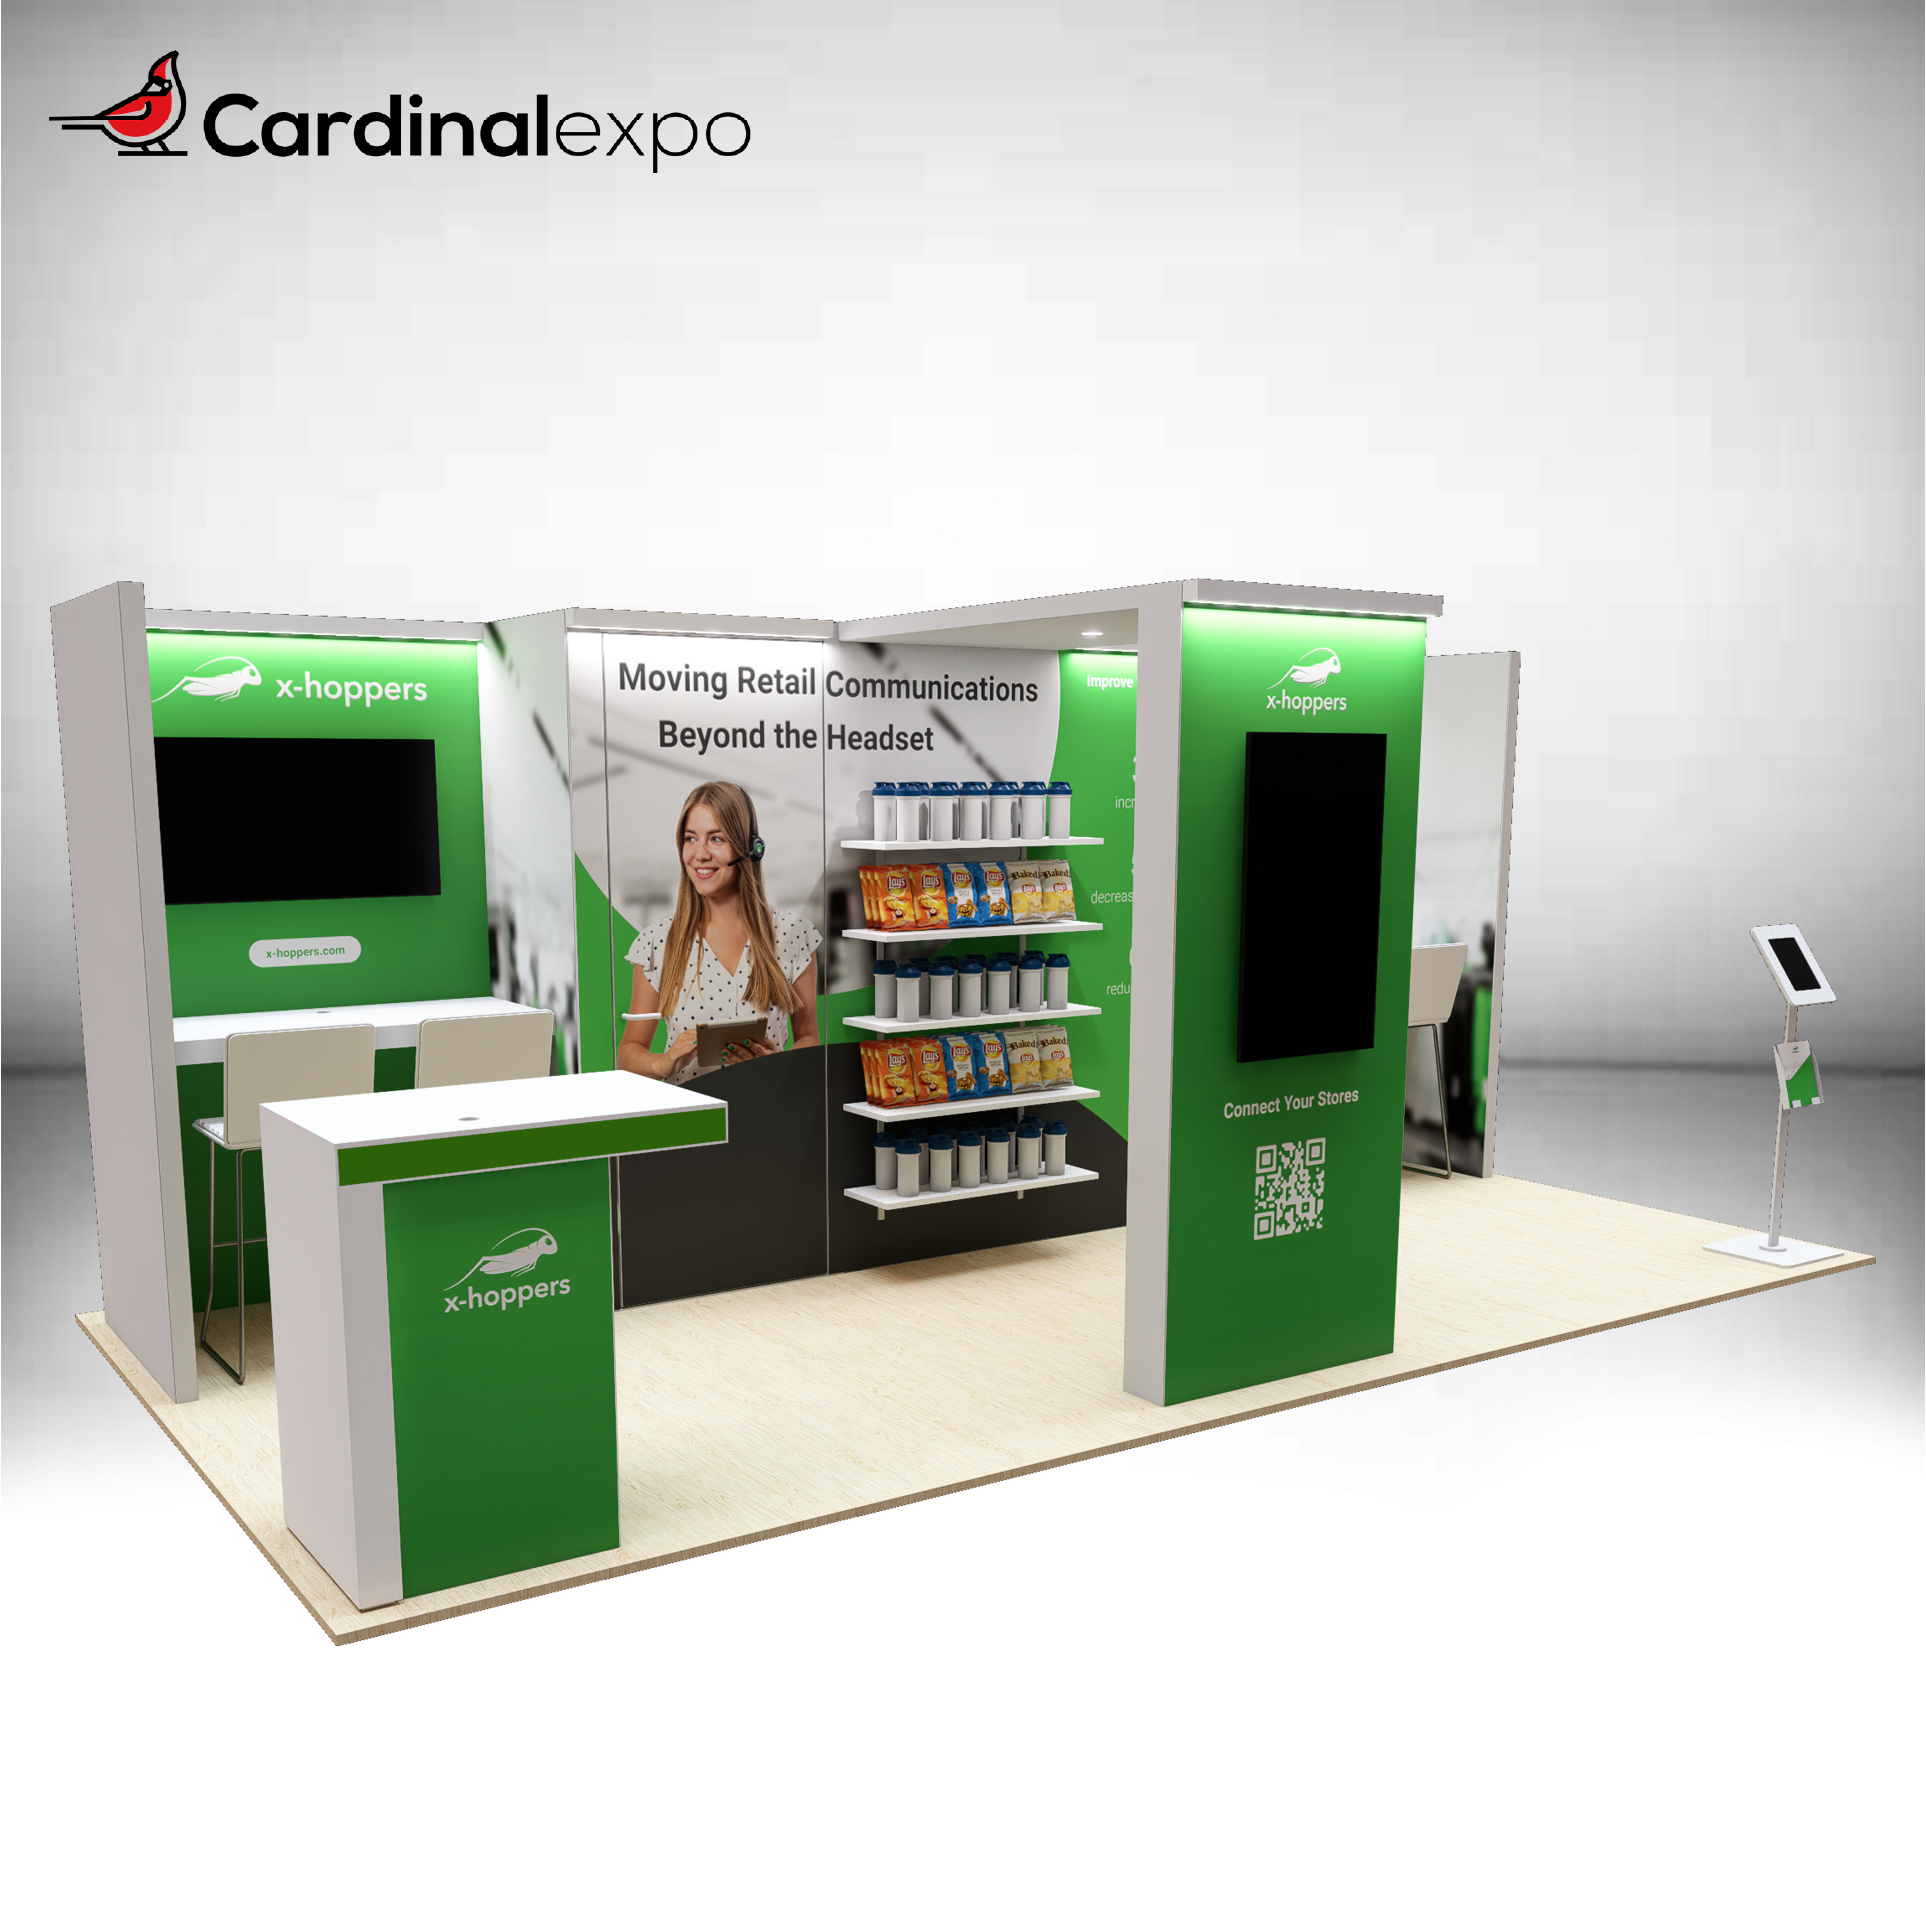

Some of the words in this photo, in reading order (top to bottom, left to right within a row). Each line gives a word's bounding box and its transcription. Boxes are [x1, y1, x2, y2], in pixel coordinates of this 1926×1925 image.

[275, 670, 428, 708] x-hoppers
[618, 662, 728, 700] Moving
[737, 665, 816, 695] Retail
[825, 670, 1038, 702] Communications
[1086, 673, 1134, 691] Improve
[1265, 688, 1347, 717] x-hoppers
[658, 720, 765, 756] Beyond
[773, 720, 818, 749] the
[827, 724, 934, 751] Headset
[1090, 890, 1134, 904] decreas
[265, 946, 346, 960] x-hoppers.com
[1106, 981, 1131, 996] redu
[1223, 1097, 1281, 1119] Connect
[1284, 1094, 1315, 1111] Your
[1317, 1089, 1360, 1107] Stores
[444, 1278, 571, 1313] x-hoppers
